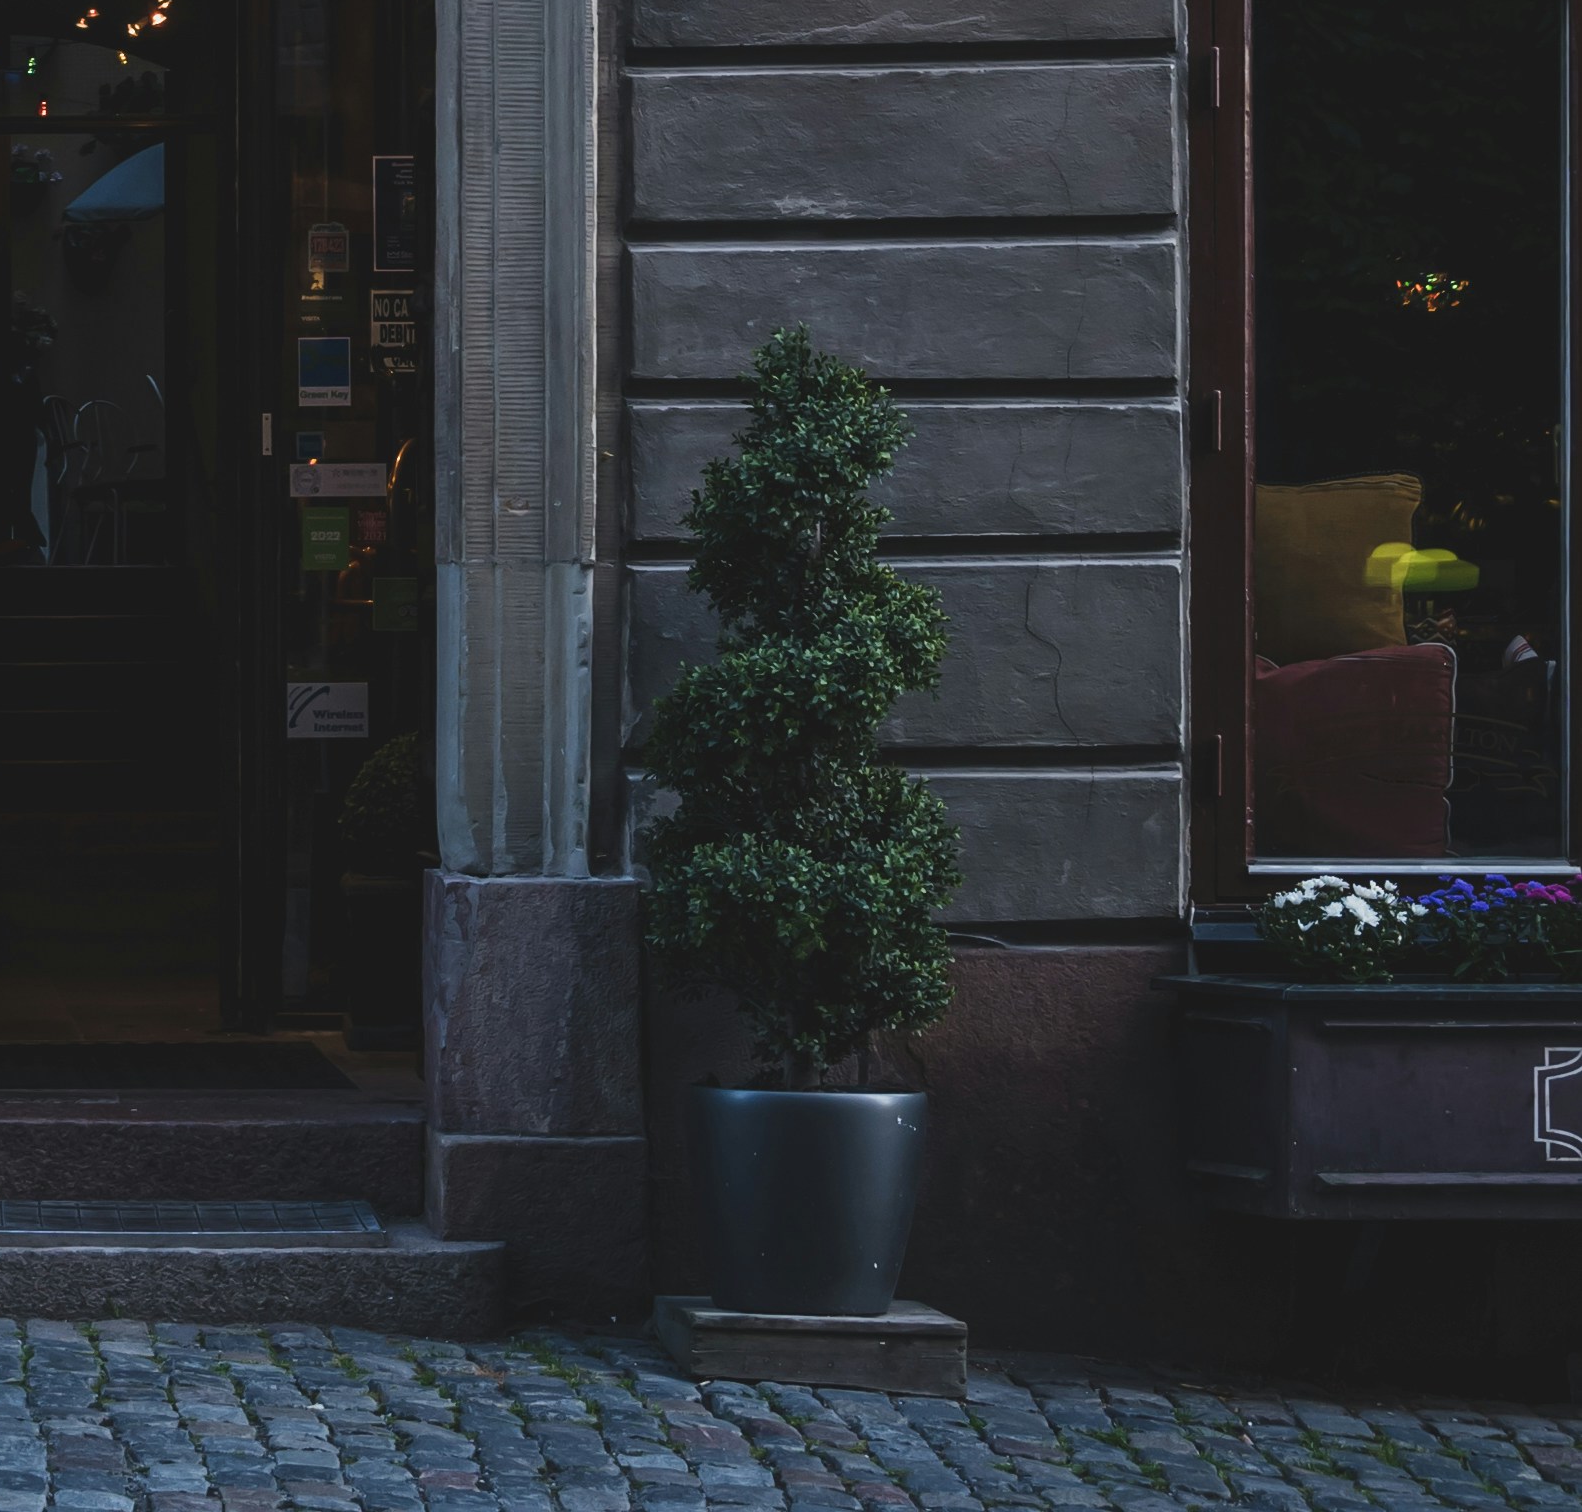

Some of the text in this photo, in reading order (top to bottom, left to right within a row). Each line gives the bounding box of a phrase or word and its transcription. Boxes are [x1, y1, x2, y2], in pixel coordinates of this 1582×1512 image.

[374, 298, 409, 318] NO CA
[299, 390, 349, 400] Green Key
[313, 709, 365, 719] Wireless
[313, 722, 365, 733] Internet
